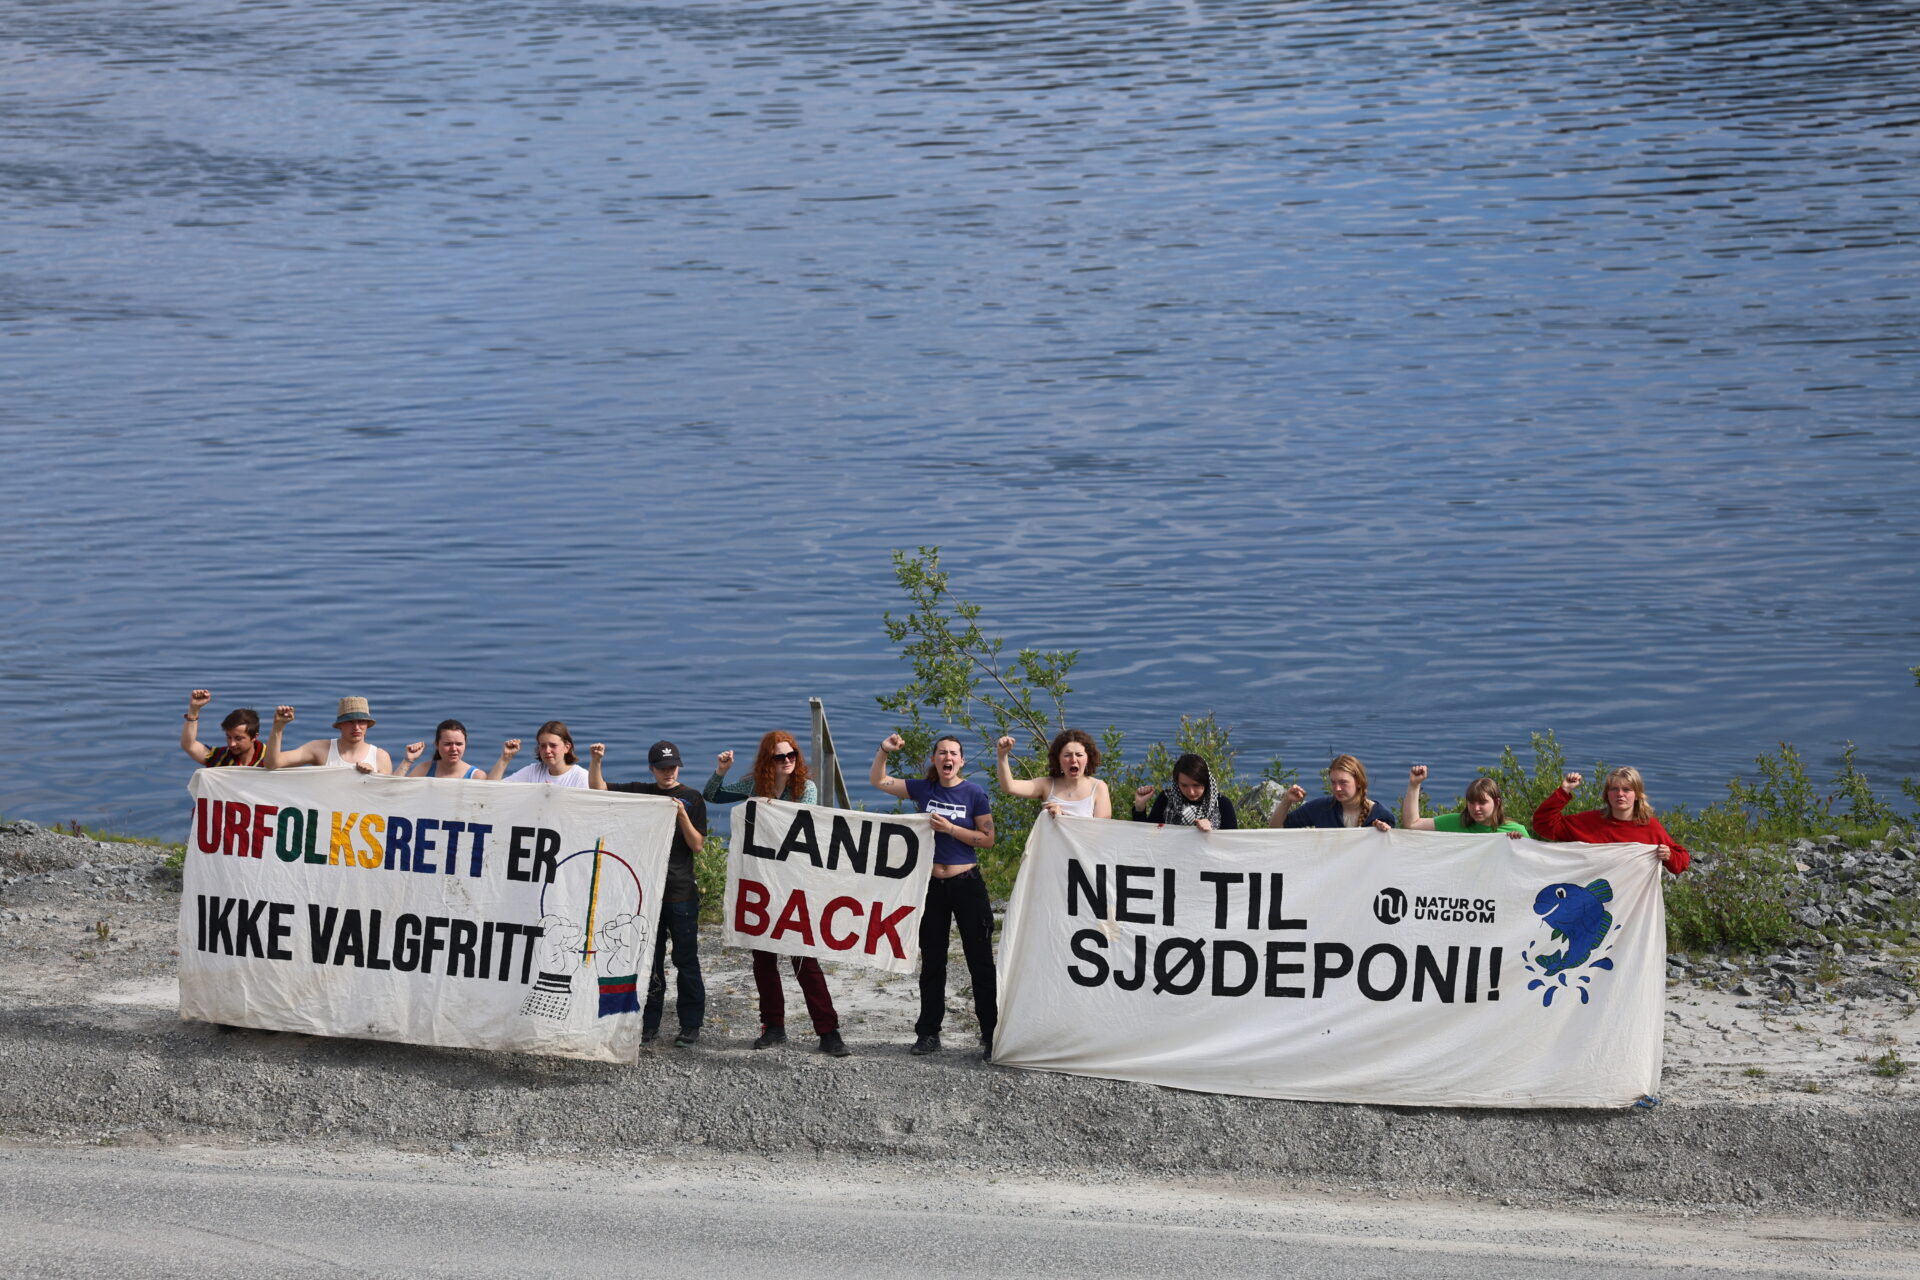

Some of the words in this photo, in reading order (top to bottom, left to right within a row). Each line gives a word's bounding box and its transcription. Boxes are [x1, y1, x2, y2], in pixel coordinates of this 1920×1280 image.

[197, 797, 492, 877] URFOLKSRETT
[506, 826, 561, 884] ER
[743, 801, 919, 878] LAND
[735, 878, 916, 959] BACK
[1067, 858, 1176, 926] NEI
[1200, 871, 1308, 930] TIL
[1414, 908, 1495, 923] UNGDOM
[1415, 896, 1469, 910] NATUR
[1473, 898, 1496, 911] OG
[197, 894, 295, 961] IKKE
[308, 903, 544, 984] VALGFRITT
[1067, 929, 1503, 1003] SJØDEPONI!
